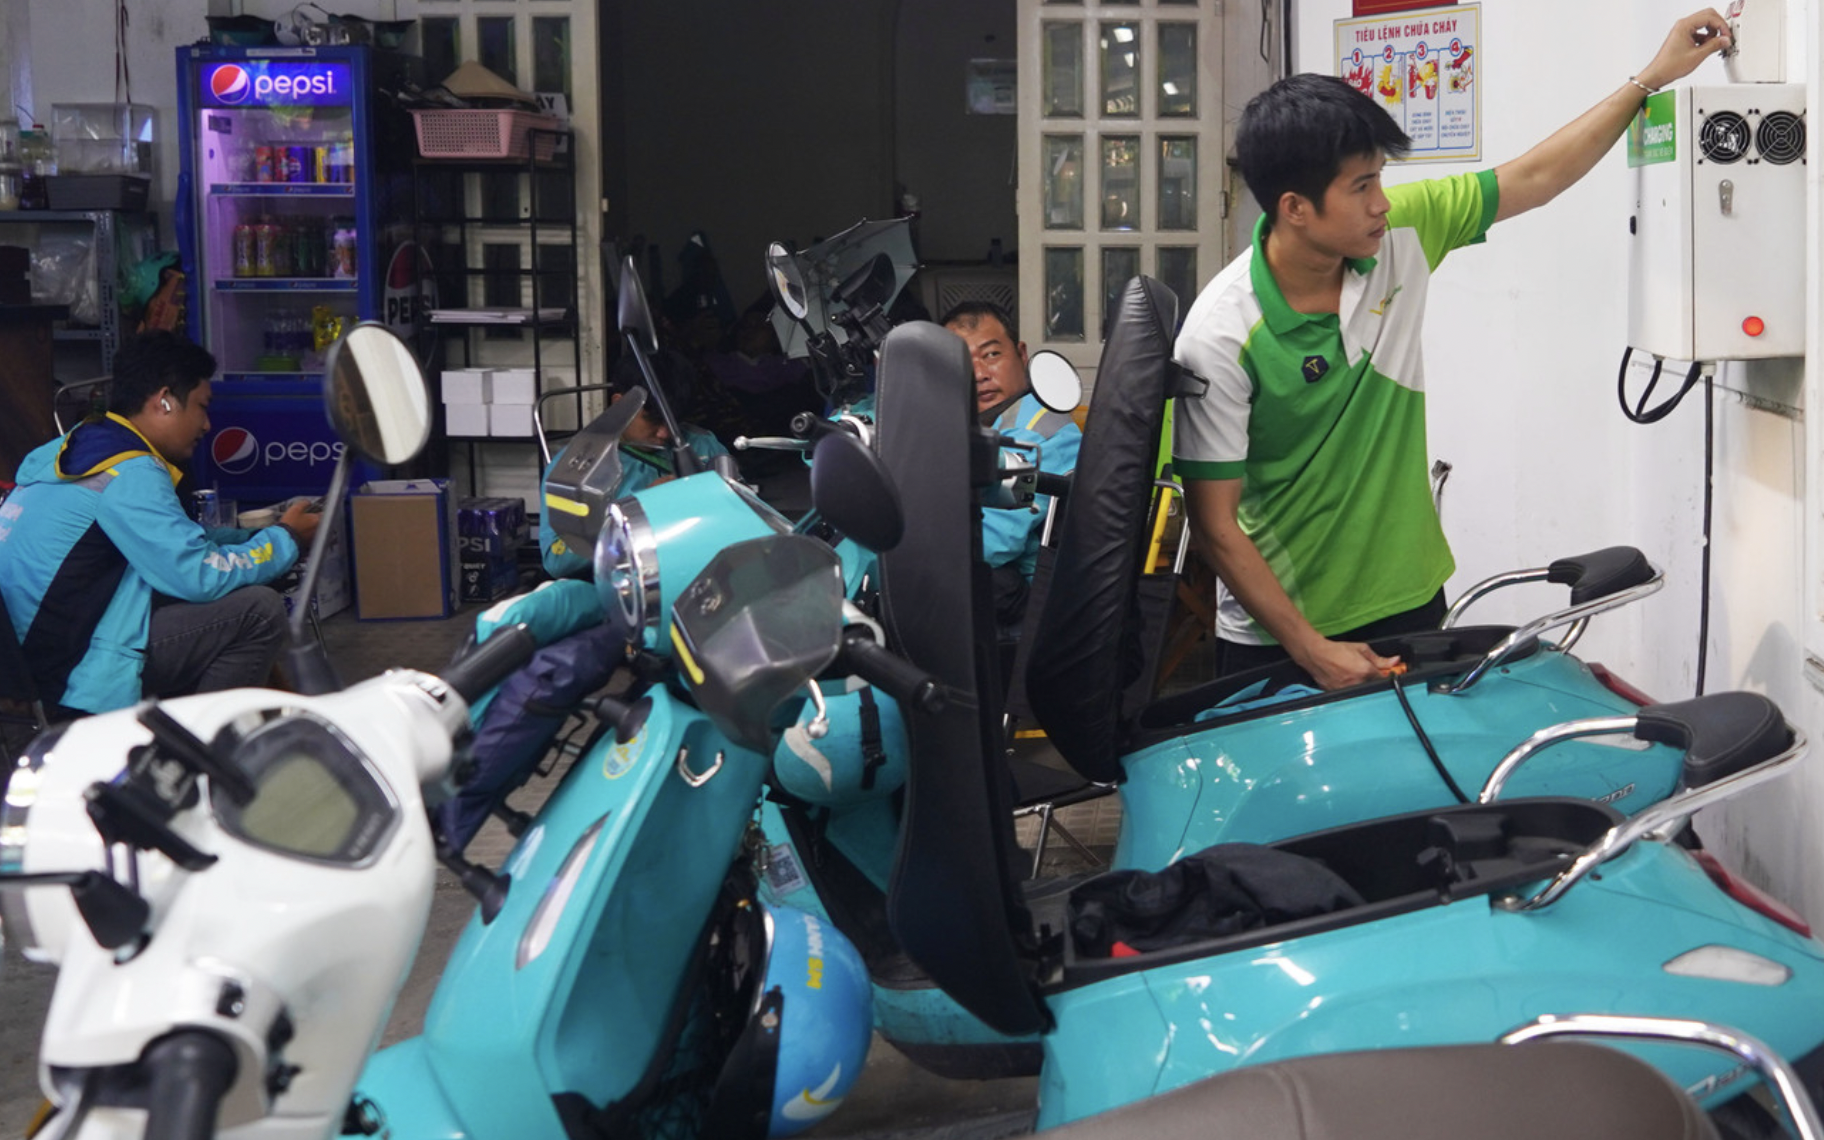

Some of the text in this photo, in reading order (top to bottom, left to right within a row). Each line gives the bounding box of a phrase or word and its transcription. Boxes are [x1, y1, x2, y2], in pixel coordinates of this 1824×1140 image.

[1378, 24, 1400, 42] LỆNH
[1385, 47, 1392, 60] 2
[1418, 43, 1425, 57] 3
[1451, 41, 1460, 53] 4
[1354, 51, 1360, 63] 1
[255, 70, 335, 100] pepsi
[265, 441, 345, 466] peps
